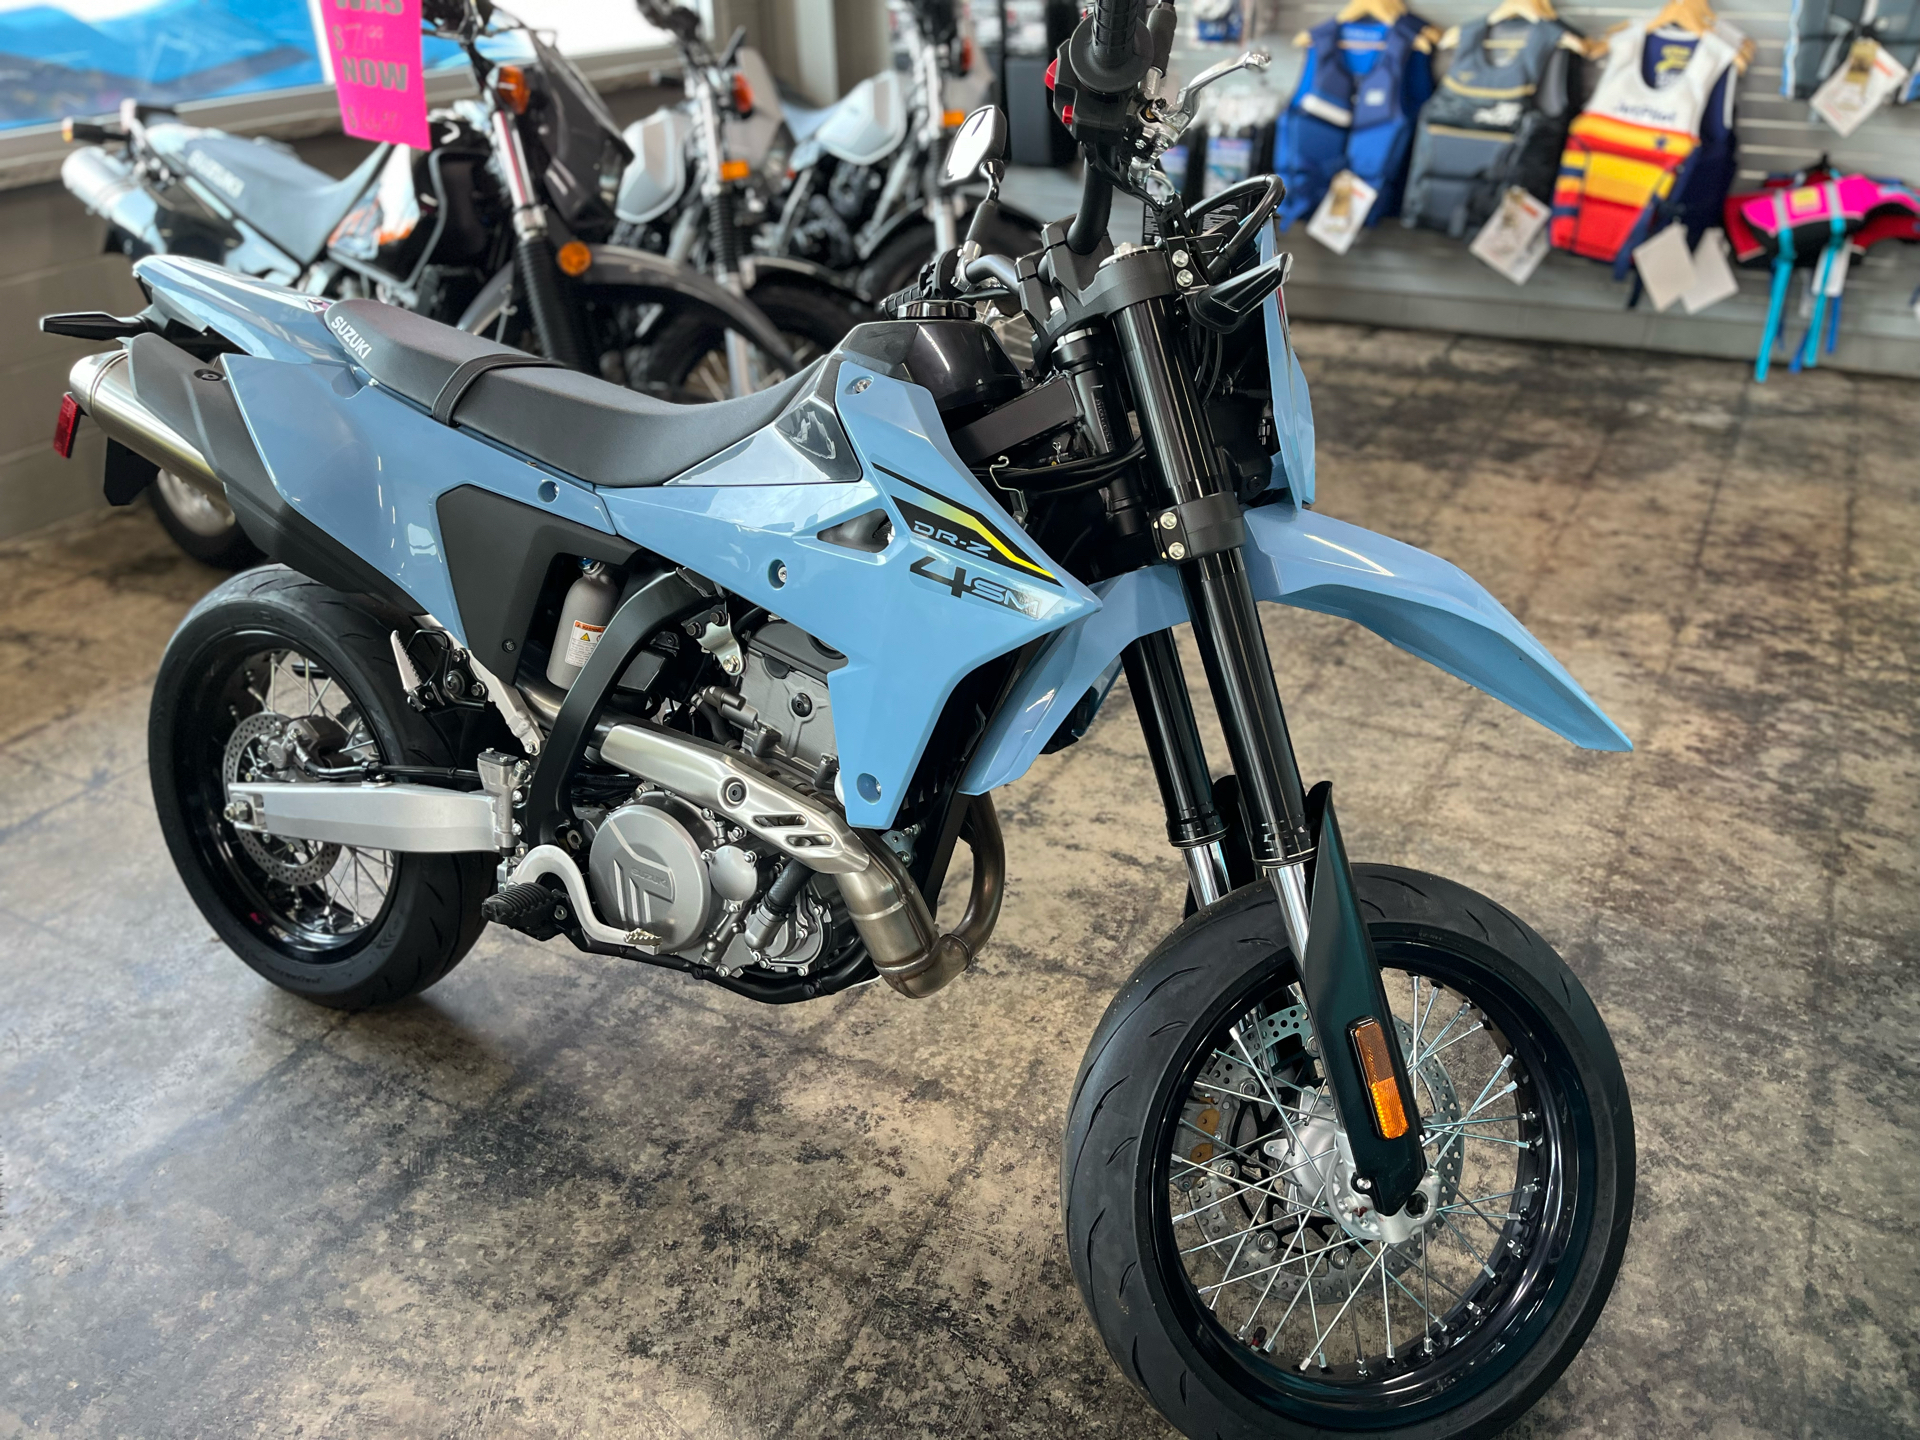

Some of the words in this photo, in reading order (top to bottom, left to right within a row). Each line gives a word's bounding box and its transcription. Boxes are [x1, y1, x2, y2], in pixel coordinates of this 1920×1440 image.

[342, 57, 409, 91] NOW
[331, 316, 372, 359] SUZUKI
[914, 520, 992, 557] DR-Z
